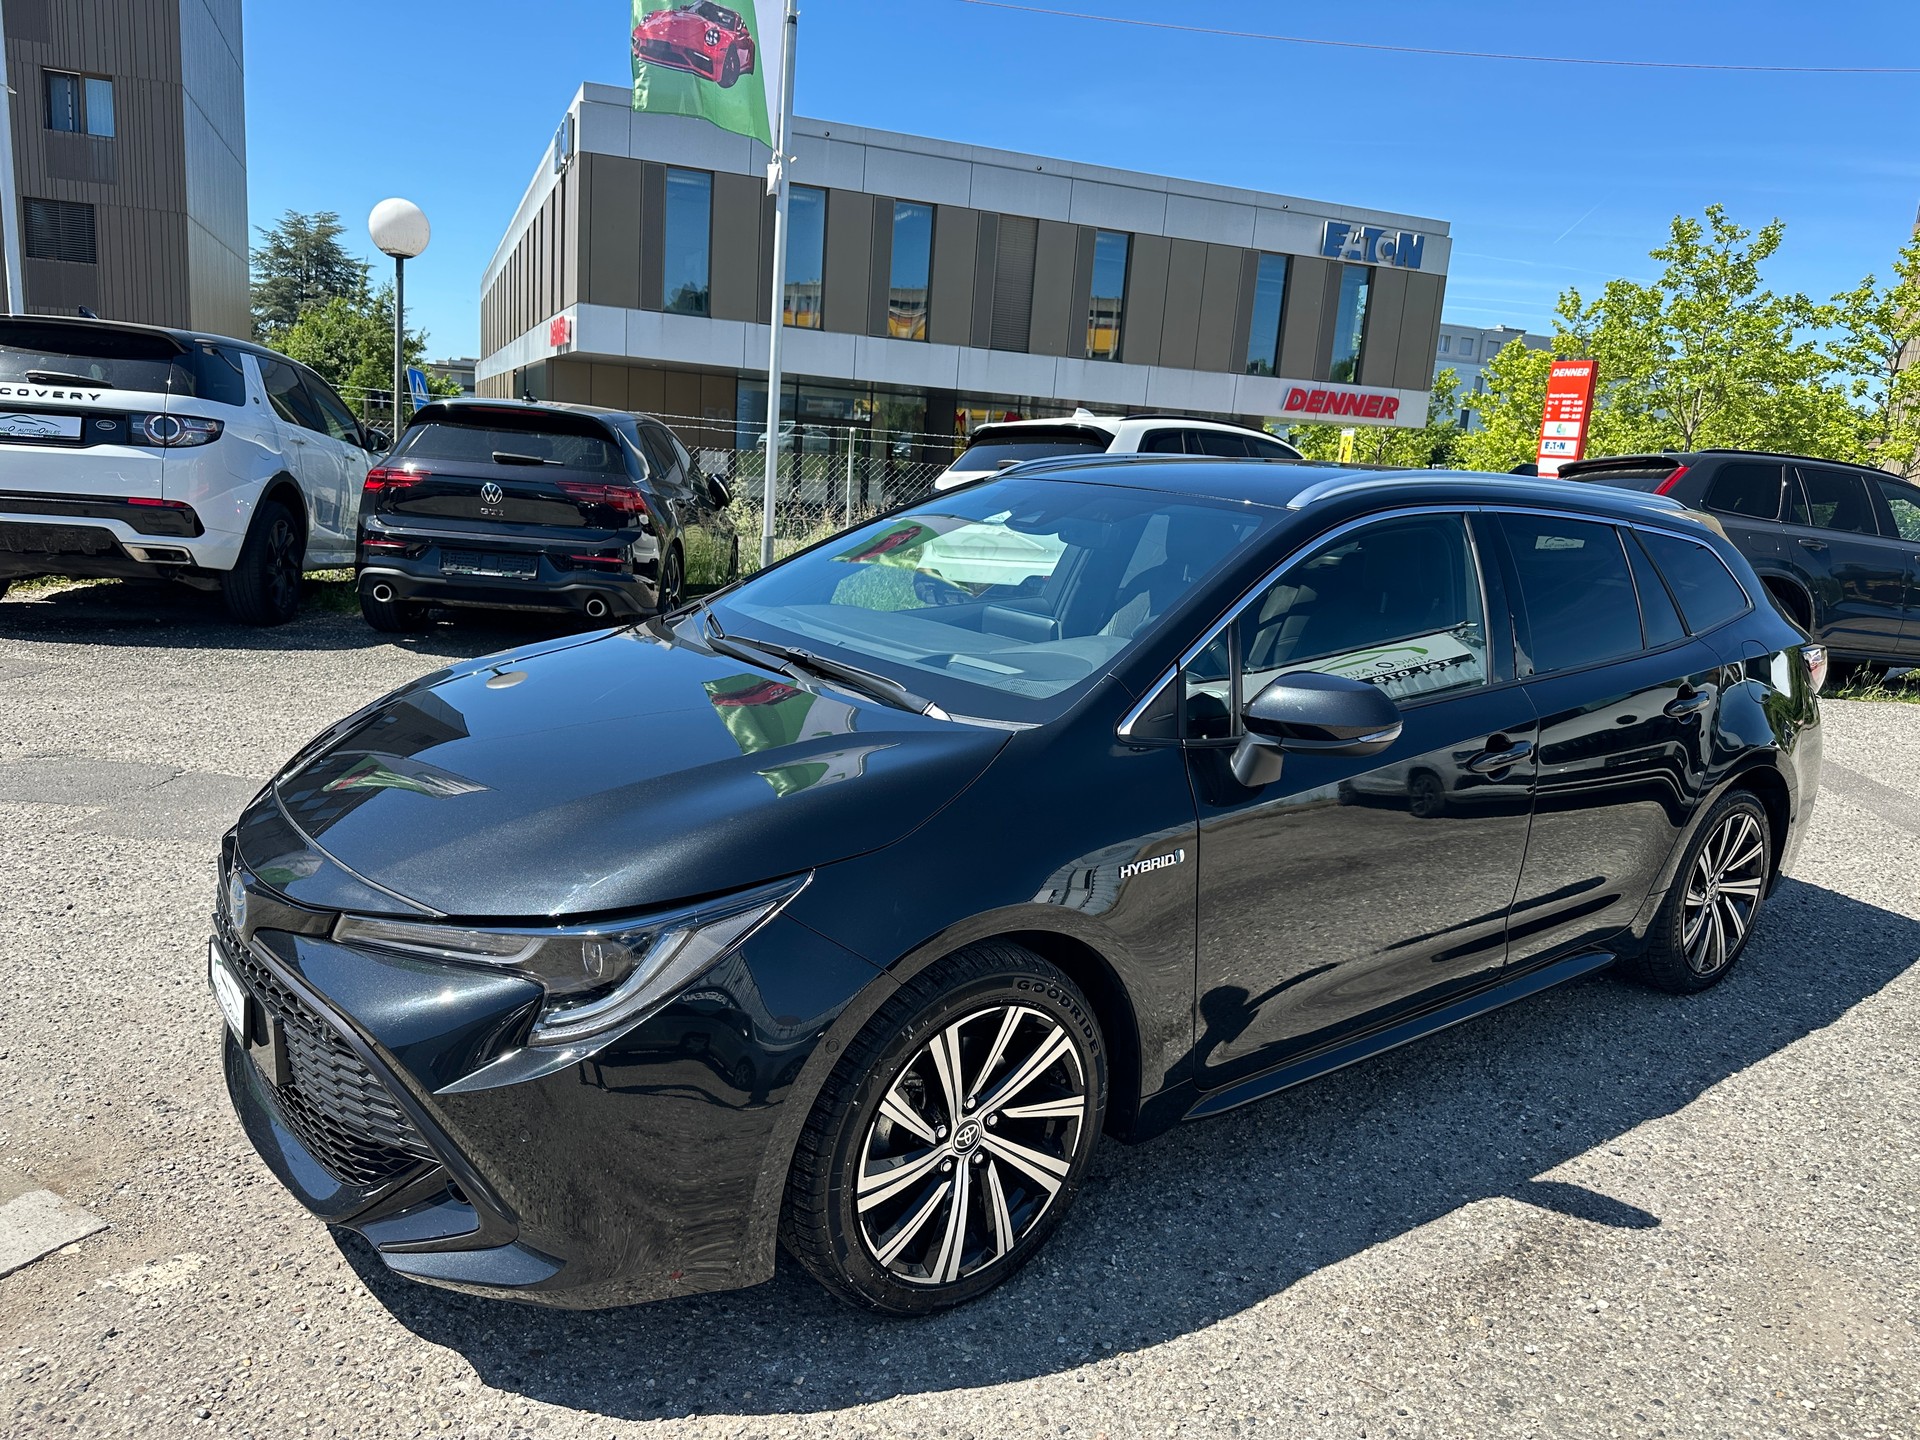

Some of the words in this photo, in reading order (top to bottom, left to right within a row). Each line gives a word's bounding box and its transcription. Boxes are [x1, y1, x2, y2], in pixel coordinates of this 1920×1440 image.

[1321, 221, 1425, 269] EATON
[1552, 367, 1590, 378] DENNER
[0, 387, 101, 401] COVERY
[1283, 388, 1400, 419] DENNER
[480, 507, 504, 516] GTI
[1120, 853, 1177, 879] HYBRID
[1016, 980, 1099, 1054] GOODRIDE
